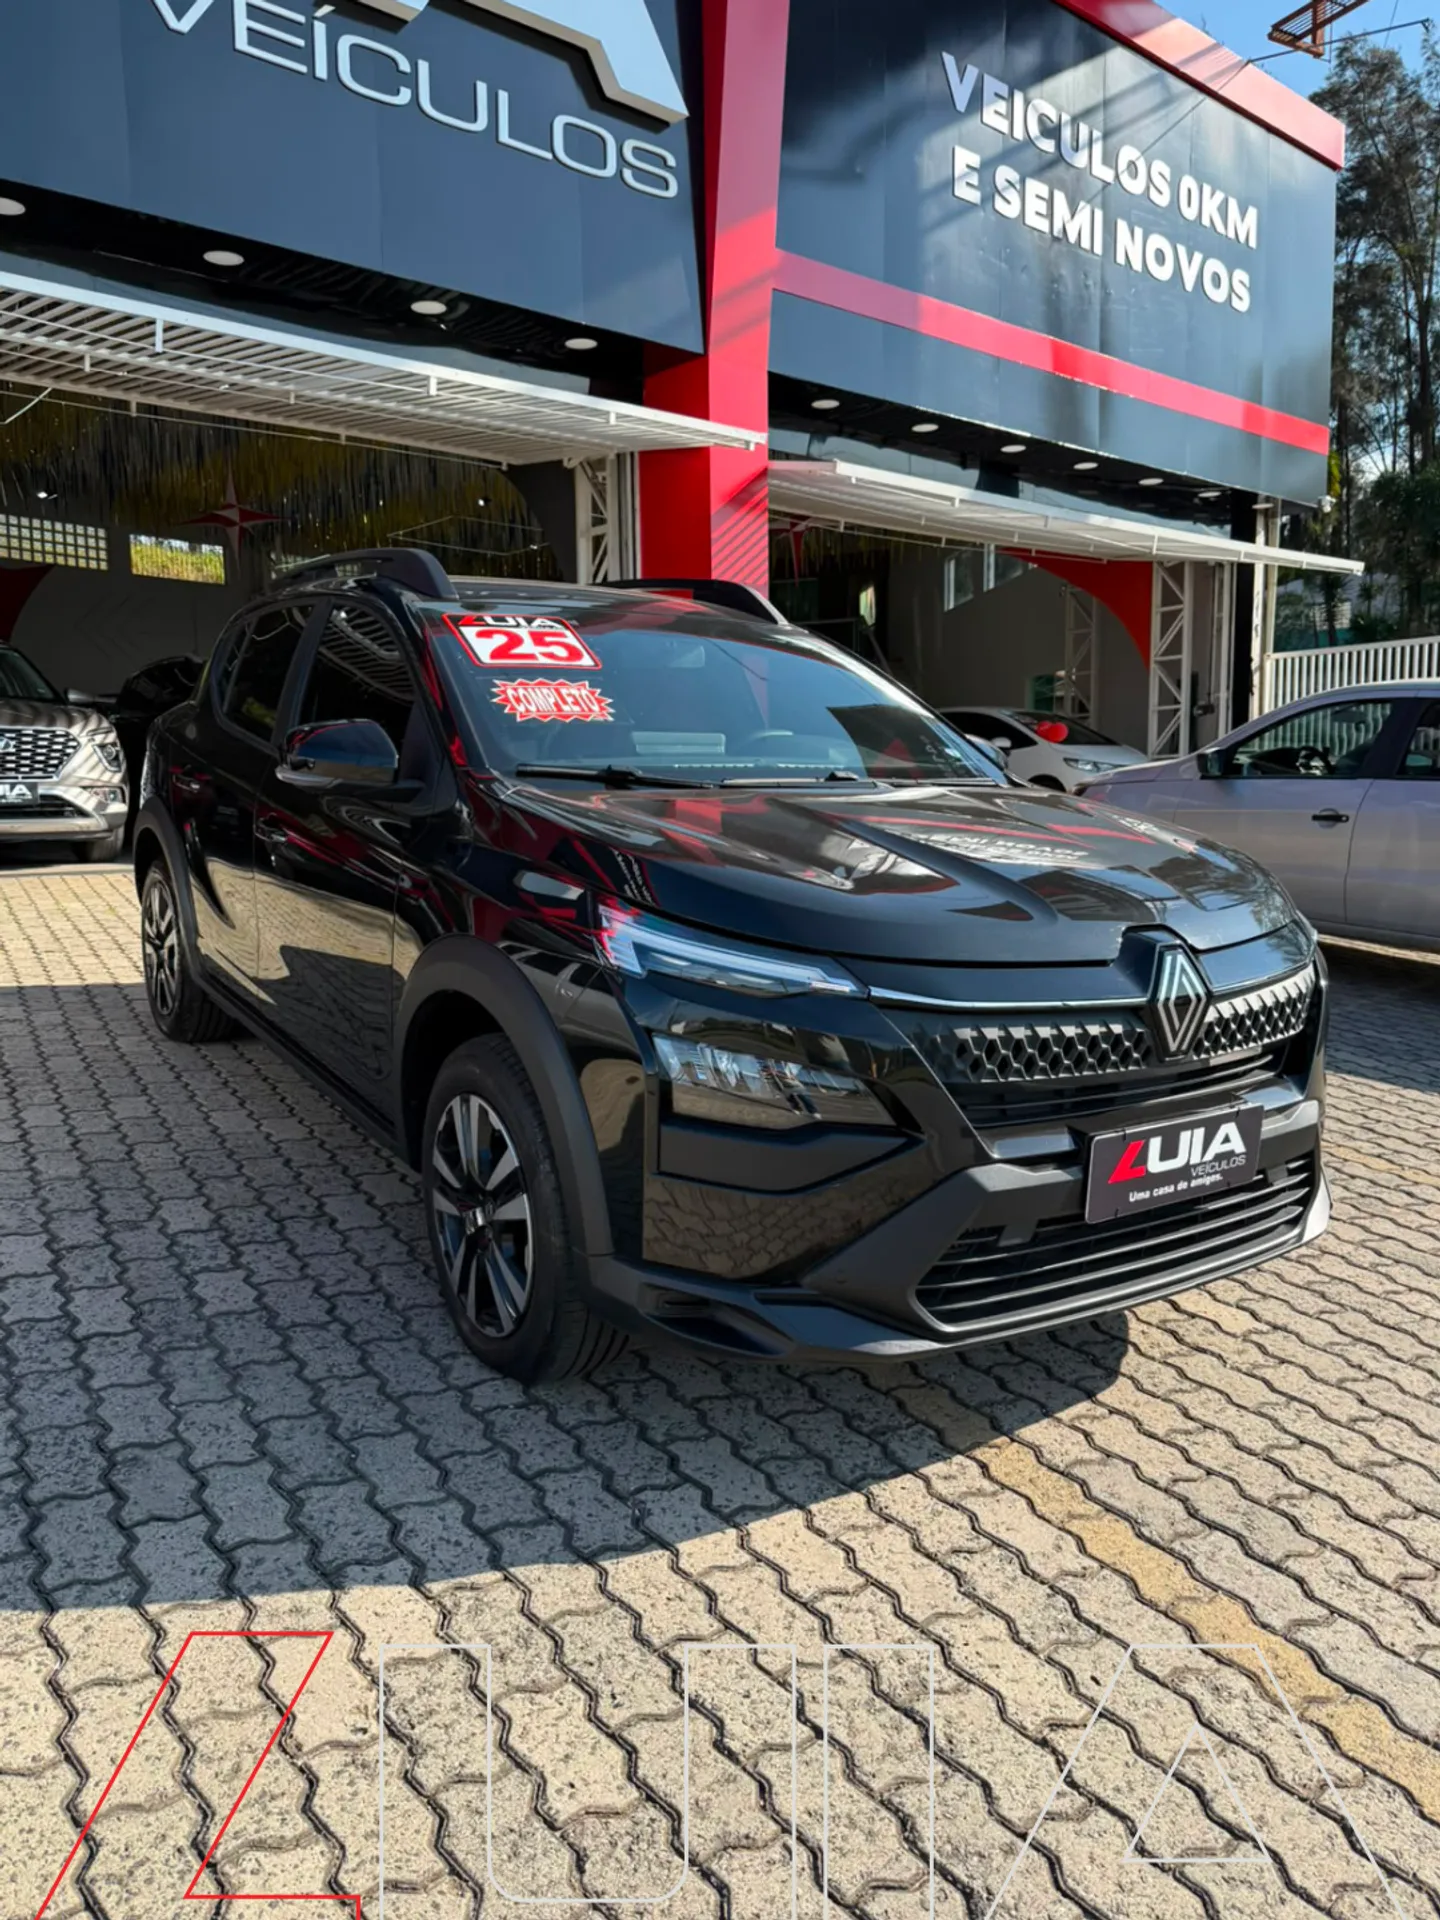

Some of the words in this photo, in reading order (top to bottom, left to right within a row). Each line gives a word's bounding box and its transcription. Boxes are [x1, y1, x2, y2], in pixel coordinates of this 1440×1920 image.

[942, 51, 1171, 209] VEICULOS
[952, 145, 981, 206] E
[993, 164, 1104, 256] SEMI
[1115, 217, 1251, 314] NOVOS
[475, 629, 584, 662] 25
[506, 686, 601, 713] COMPLETO
[1107, 1121, 1247, 1184] LUIA
[1129, 1190, 1151, 1203] Uma
[1153, 1184, 1175, 1197] casa
[1177, 1180, 1189, 1191] de
